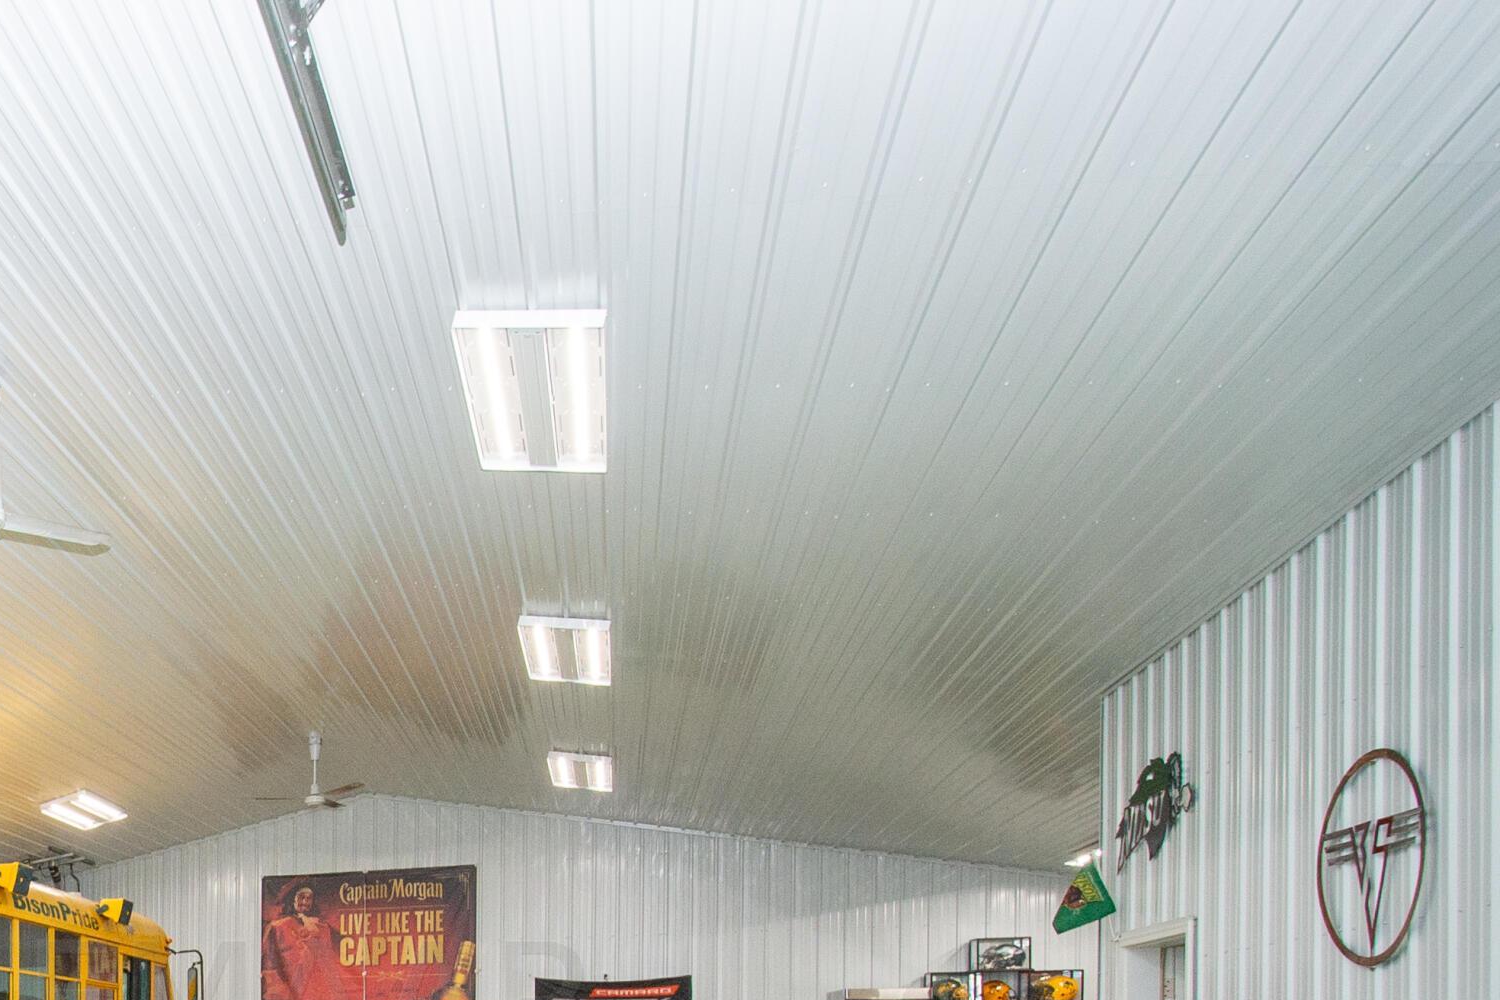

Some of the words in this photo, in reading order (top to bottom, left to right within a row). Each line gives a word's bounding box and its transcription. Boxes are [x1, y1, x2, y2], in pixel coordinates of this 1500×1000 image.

[340, 881, 388, 905] Captain
[386, 878, 443, 902] Morgan
[340, 912, 372, 936] LIVE
[377, 911, 410, 934] LIKE
[414, 909, 444, 933] THE
[339, 934, 445, 968] CAPTAIN
[595, 986, 673, 997] CAMARO
